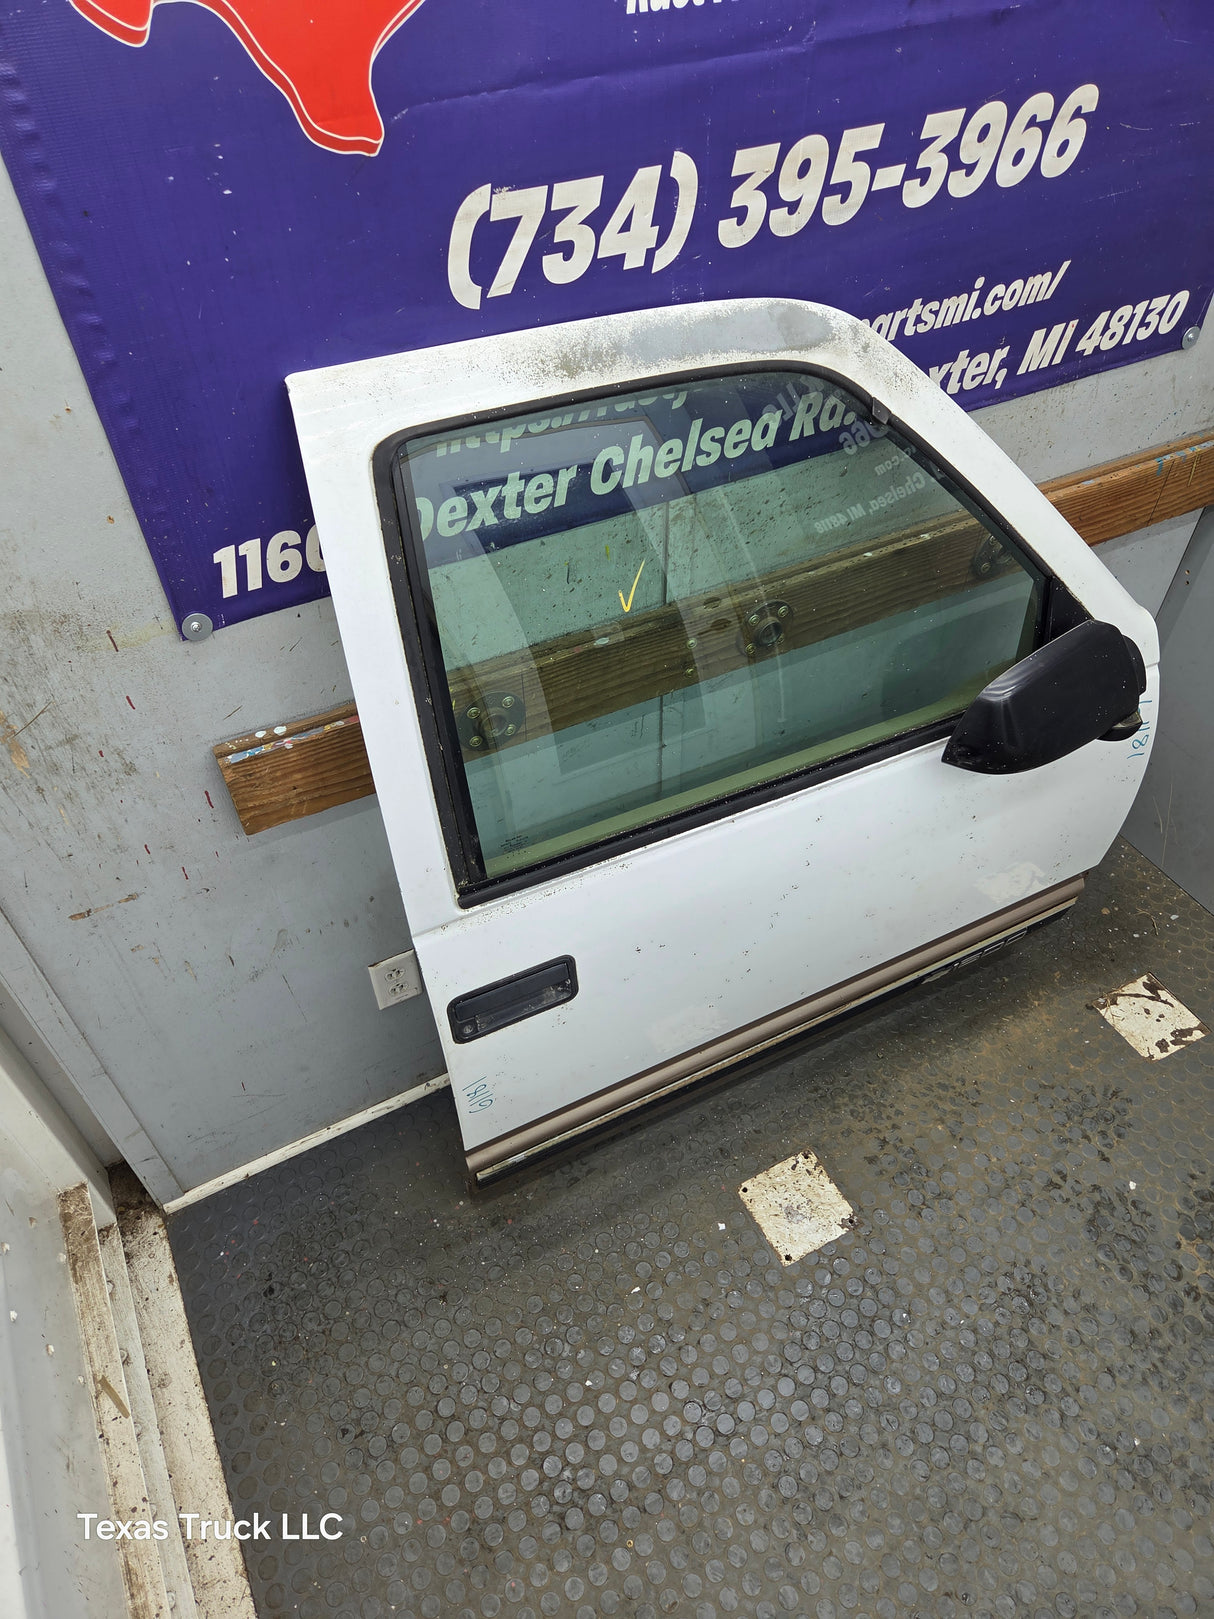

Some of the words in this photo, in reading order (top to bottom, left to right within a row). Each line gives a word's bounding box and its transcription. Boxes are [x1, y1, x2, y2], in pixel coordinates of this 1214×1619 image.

[448, 151, 698, 310] (734)
[718, 84, 1099, 248] 395-3966
[590, 409, 783, 496] Chelsea
[1016, 319, 1079, 376] MI
[1075, 290, 1190, 356] 48130
